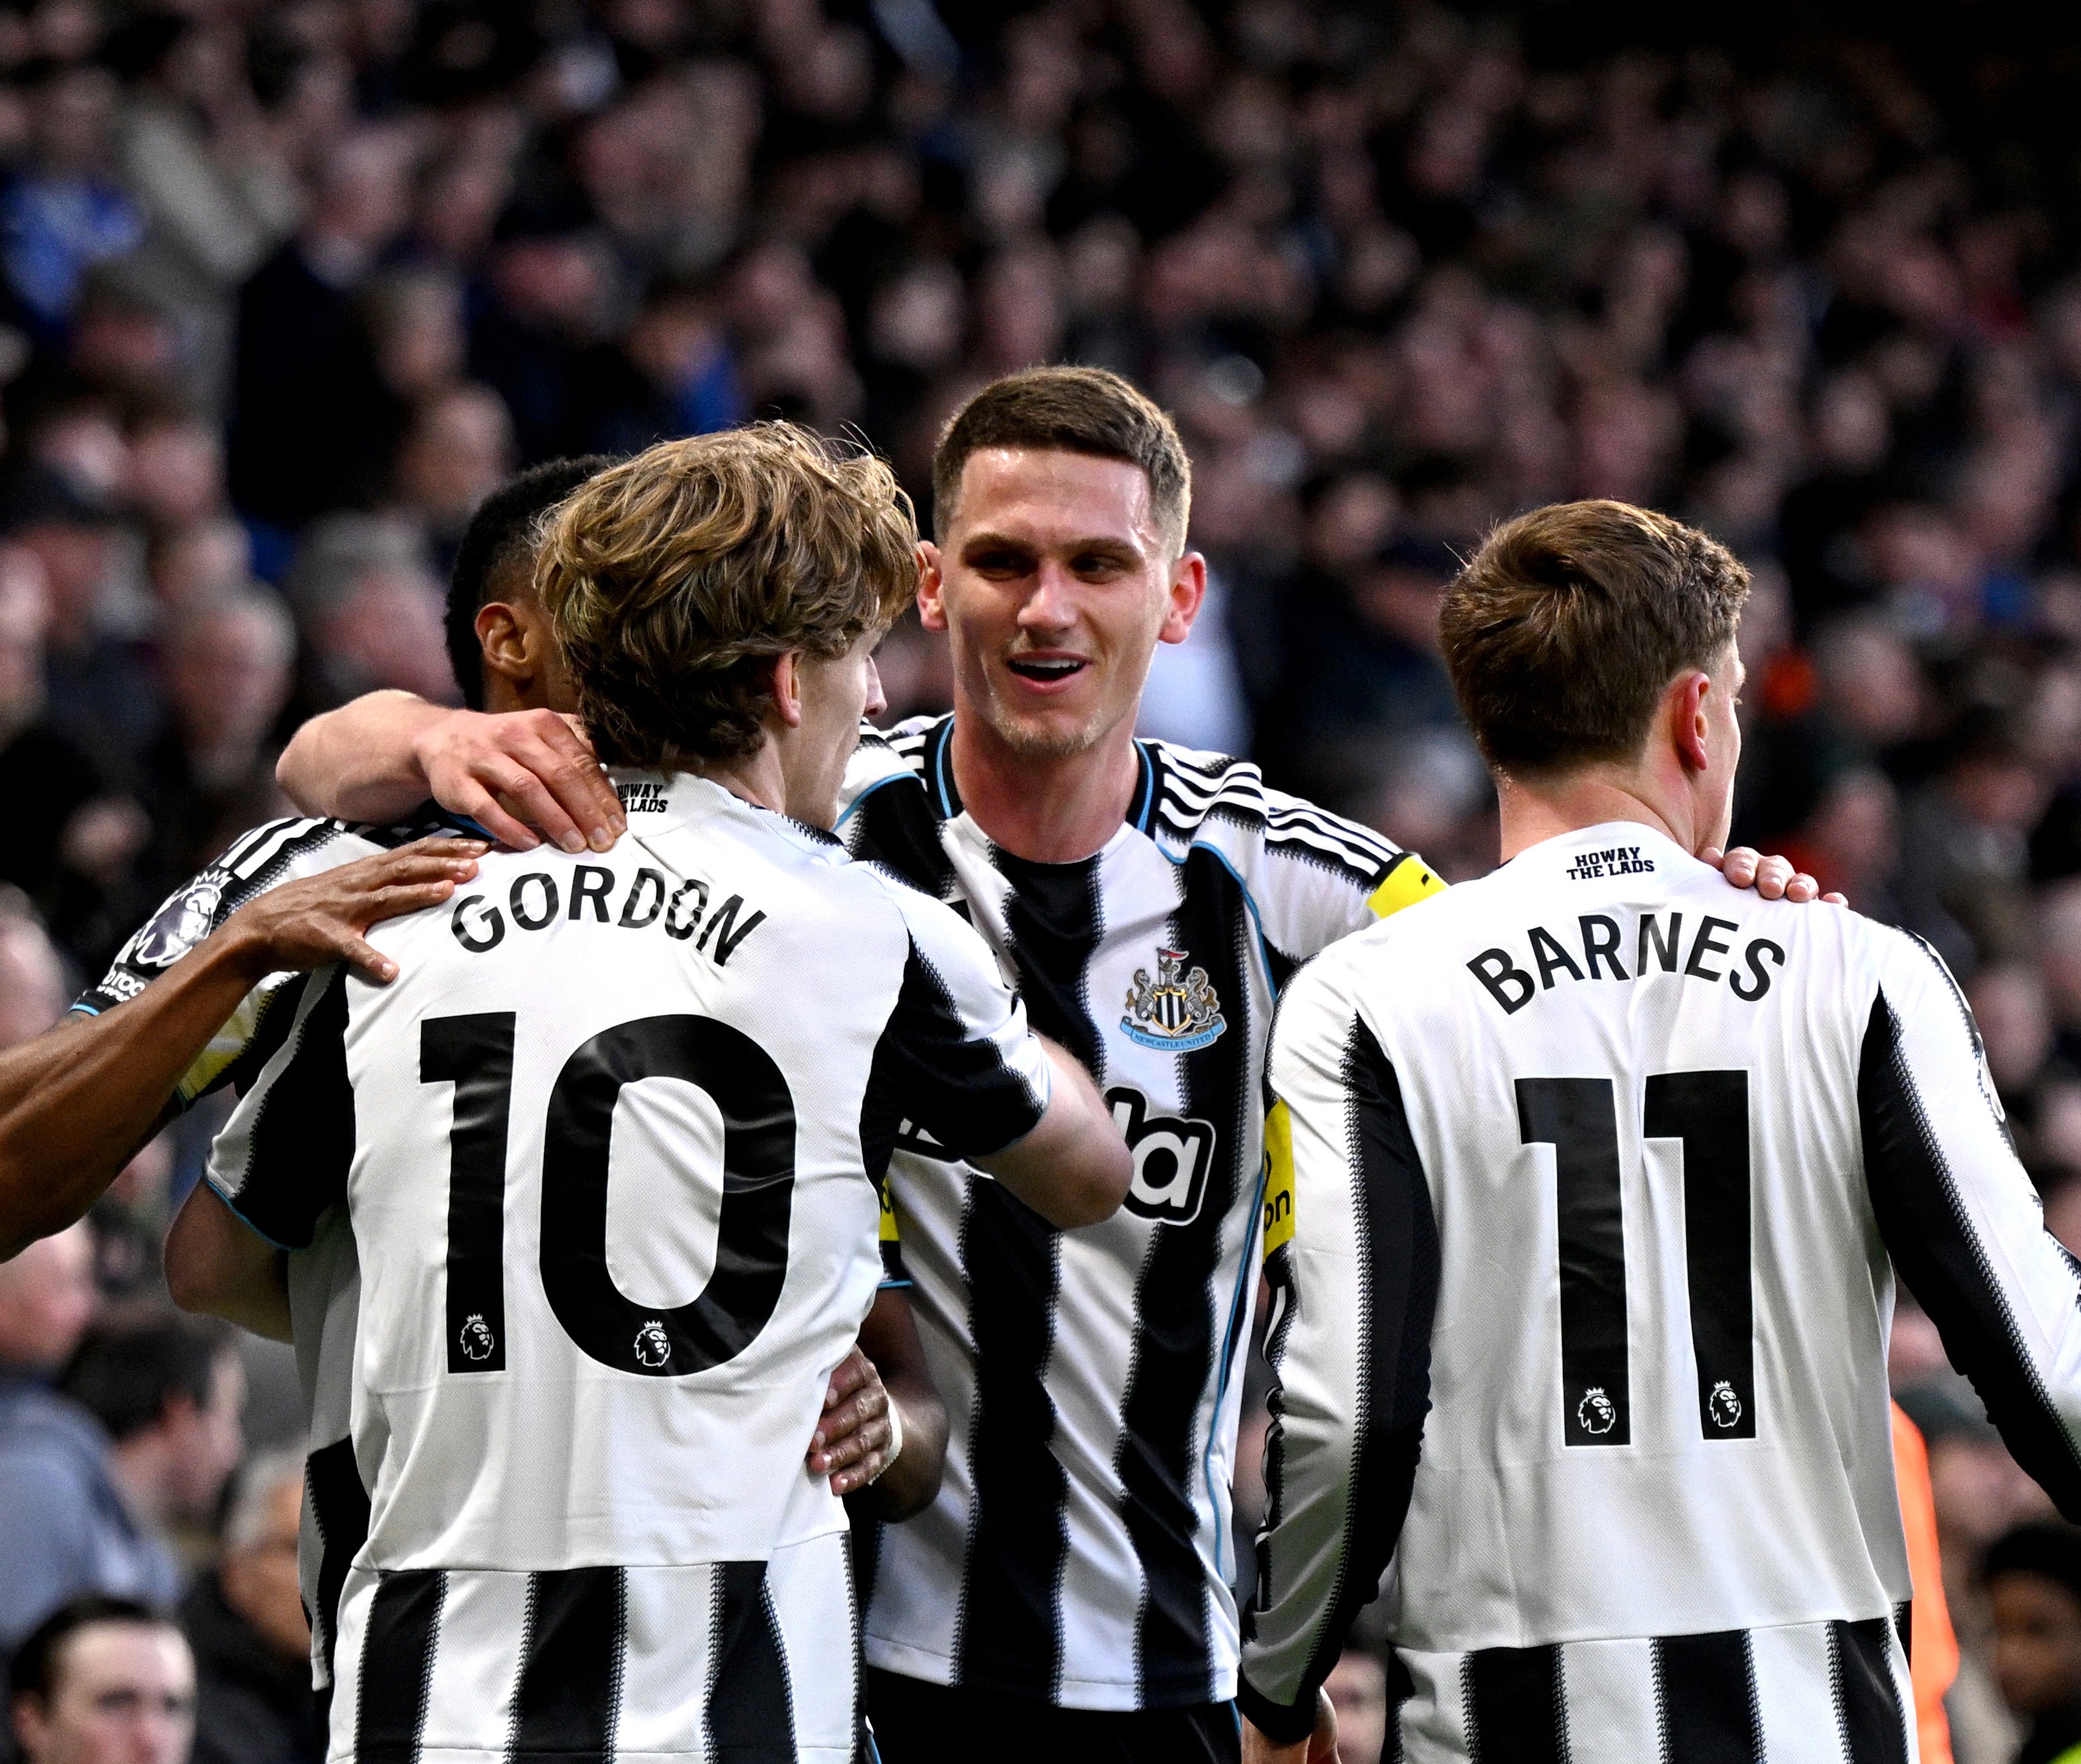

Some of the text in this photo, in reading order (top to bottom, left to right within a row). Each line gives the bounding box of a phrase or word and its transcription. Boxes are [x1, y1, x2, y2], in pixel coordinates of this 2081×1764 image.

[616, 783, 664, 798] HOWAY
[630, 799, 668, 813] LADS
[1574, 846, 1640, 867] HOWAY
[1566, 860, 1655, 880] THE LADS
[451, 864, 768, 968] GORDON
[1466, 912, 1786, 1015] BARNES
[1134, 1033, 1211, 1048] NEWCASTLE UNITED
[420, 1011, 797, 1377] 10
[1514, 1069, 1756, 1447] 11
